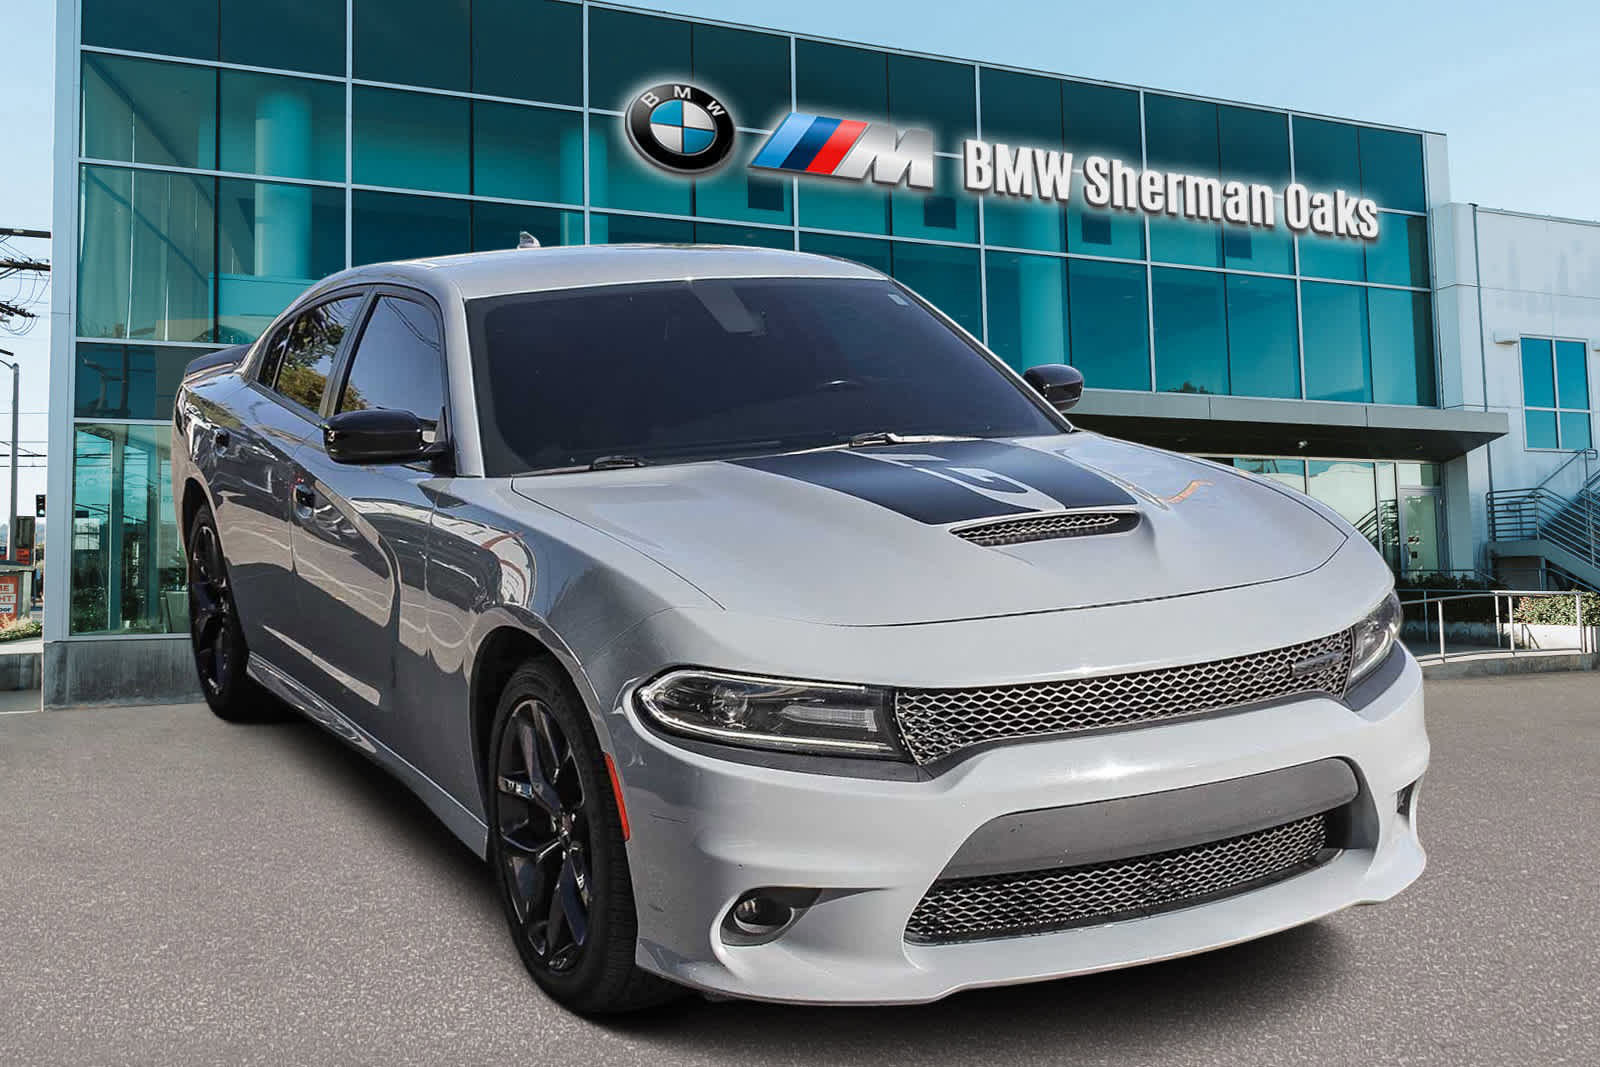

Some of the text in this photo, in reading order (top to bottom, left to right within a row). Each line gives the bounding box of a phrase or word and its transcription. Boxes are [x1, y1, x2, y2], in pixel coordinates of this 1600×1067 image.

[640, 85, 725, 117] BMW
[963, 139, 1379, 240] BMW Sherman Oaks
